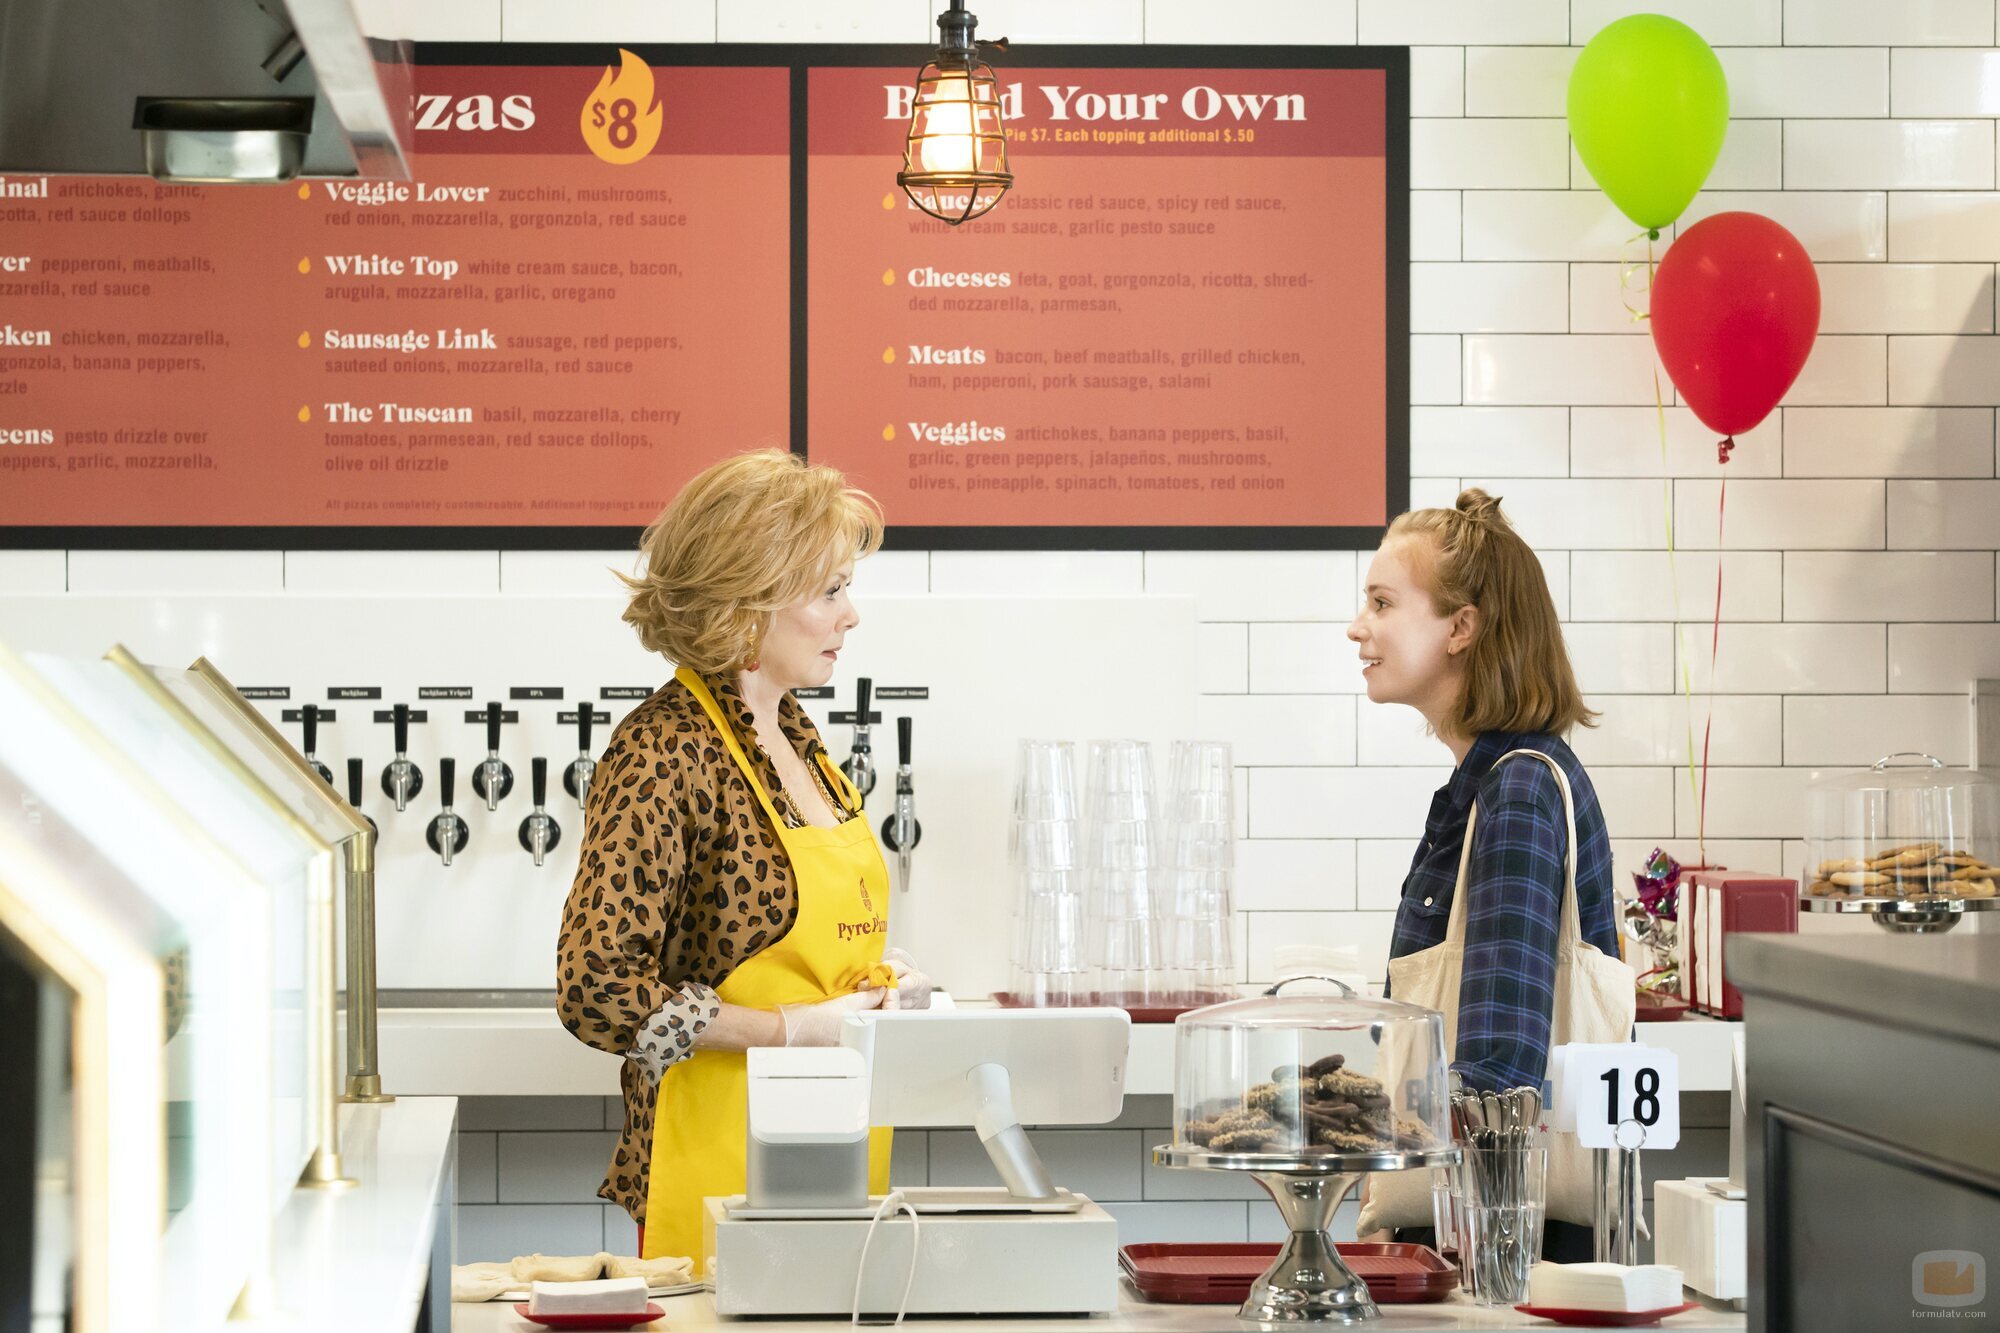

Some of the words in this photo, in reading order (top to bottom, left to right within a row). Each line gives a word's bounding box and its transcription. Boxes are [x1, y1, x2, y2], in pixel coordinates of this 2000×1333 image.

[883, 82, 1025, 121] Bld
[1039, 85, 1169, 121] Your
[1181, 86, 1306, 121] Own
[410, 94, 536, 131] zas
[592, 97, 638, 150] $8
[1005, 128, 1027, 142] Pie
[1030, 127, 1051, 143] $7.
[1055, 128, 1089, 142] Each
[1092, 128, 1146, 145] topping
[1149, 128, 1220, 142] additional
[1223, 128, 1254, 143] $.50
[58, 182, 148, 199] artichokes,
[154, 184, 207, 201] garlic,
[325, 181, 409, 206] Veggie
[417, 182, 490, 202] Lover
[498, 185, 572, 203] zucchini,
[577, 186, 673, 204] mushrooms,
[907, 190, 998, 210] Sauces
[1006, 194, 1063, 211] classic
[1067, 194, 1094, 211] red
[1099, 197, 1151, 212] sauce,
[1156, 194, 1199, 214] spicy
[1204, 195, 1230, 211] red
[1235, 197, 1287, 213] sauce,
[47, 206, 74, 223] red
[79, 209, 127, 223] sauce
[132, 206, 191, 226] dollops
[324, 209, 351, 226] red
[356, 212, 406, 228] onion,
[411, 210, 504, 228] mozzarella,
[509, 210, 603, 230] gorgonzola,
[608, 211, 635, 227] red
[639, 214, 687, 227] sauce
[907, 219, 952, 236] white
[957, 222, 1006, 236] cream
[1011, 221, 1063, 238] sauce,
[1069, 219, 1115, 239] garlic
[1120, 220, 1163, 239] pesto
[1168, 222, 1216, 236] sauce
[41, 256, 127, 275] pepperoni,
[132, 256, 216, 274] meatballs,
[325, 254, 404, 276] White
[410, 256, 459, 281] Top
[467, 259, 511, 276] white
[516, 262, 566, 275] cream
[571, 262, 624, 278] sauce,
[629, 260, 683, 278] bacon,
[71, 280, 98, 296] red
[103, 283, 151, 297] sauce
[907, 266, 1011, 288] Cheeses
[1017, 271, 1053, 289] feta,
[1058, 273, 1098, 291] goat,
[1103, 272, 1196, 291] gorgonzola,
[1201, 271, 1258, 289] ricotta,
[1263, 272, 1314, 288] shred-
[324, 284, 390, 303] arugula,
[396, 284, 489, 301] mozzarella,
[494, 284, 546, 303] garlic,
[551, 287, 616, 304] oregano
[908, 295, 937, 312] ded
[942, 296, 1035, 313] mozzarella,
[1040, 299, 1122, 315] parmesan,
[61, 329, 131, 347] chicken,
[136, 329, 230, 348] mozzarella,
[324, 329, 430, 353] Sausage
[437, 327, 497, 349] Link
[506, 336, 577, 353] sausage,
[583, 333, 609, 350] red
[614, 336, 683, 353] peppers,
[72, 354, 132, 371] banana
[136, 357, 206, 374] peppers,
[324, 357, 388, 373] sauteed
[392, 357, 451, 375] onions,
[456, 357, 549, 375] mozzarella,
[554, 357, 581, 374] red
[585, 360, 633, 374] sauce
[908, 345, 986, 365] Meats
[994, 348, 1048, 366] bacon,
[1053, 348, 1089, 365] beef
[1093, 348, 1175, 367] meatballs,
[1180, 348, 1233, 368] grilled
[1237, 349, 1305, 366] chicken,
[908, 373, 947, 390] ham,
[952, 372, 1037, 392] pepperoni,
[1042, 373, 1078, 392] pork
[1082, 375, 1153, 392] sausage,
[1158, 372, 1211, 389] salami
[324, 402, 373, 423] The
[379, 403, 473, 423] Tuscan
[483, 406, 527, 424] basil,
[532, 407, 625, 424] mozzarella,
[630, 406, 681, 426] cherry
[64, 429, 109, 447] pesto
[113, 428, 168, 445] drizzle
[173, 431, 208, 445] over
[324, 431, 403, 448] tomatoes,
[408, 434, 500, 451] parmesean,
[506, 431, 532, 447] red
[537, 434, 585, 447] sauce
[590, 431, 654, 451] dollops,
[908, 420, 1006, 446] Veggies
[1014, 425, 1103, 443] artichokes,
[1108, 425, 1167, 442] banana
[1172, 428, 1240, 445] peppers,
[1245, 425, 1289, 443] basil,
[0, 455, 61, 472] eppers,
[67, 453, 119, 472] garlic,
[124, 453, 218, 470] mozzarella,
[324, 455, 364, 472] olive
[369, 455, 390, 471] oil
[395, 455, 449, 472] drizzle
[908, 449, 960, 470] garlic,
[965, 452, 1011, 470] green
[1015, 452, 1084, 469] peppers,
[1089, 449, 1172, 469] jalapeños,
[1177, 450, 1272, 468] mushrooms,
[908, 474, 961, 492] olives,
[966, 474, 1050, 494] pineapple,
[1055, 474, 1122, 494] spinach,
[1127, 475, 1205, 492] tomatoes,
[1210, 474, 1236, 491] red
[1241, 474, 1285, 491] onion
[1600, 1067, 1661, 1127] 18
